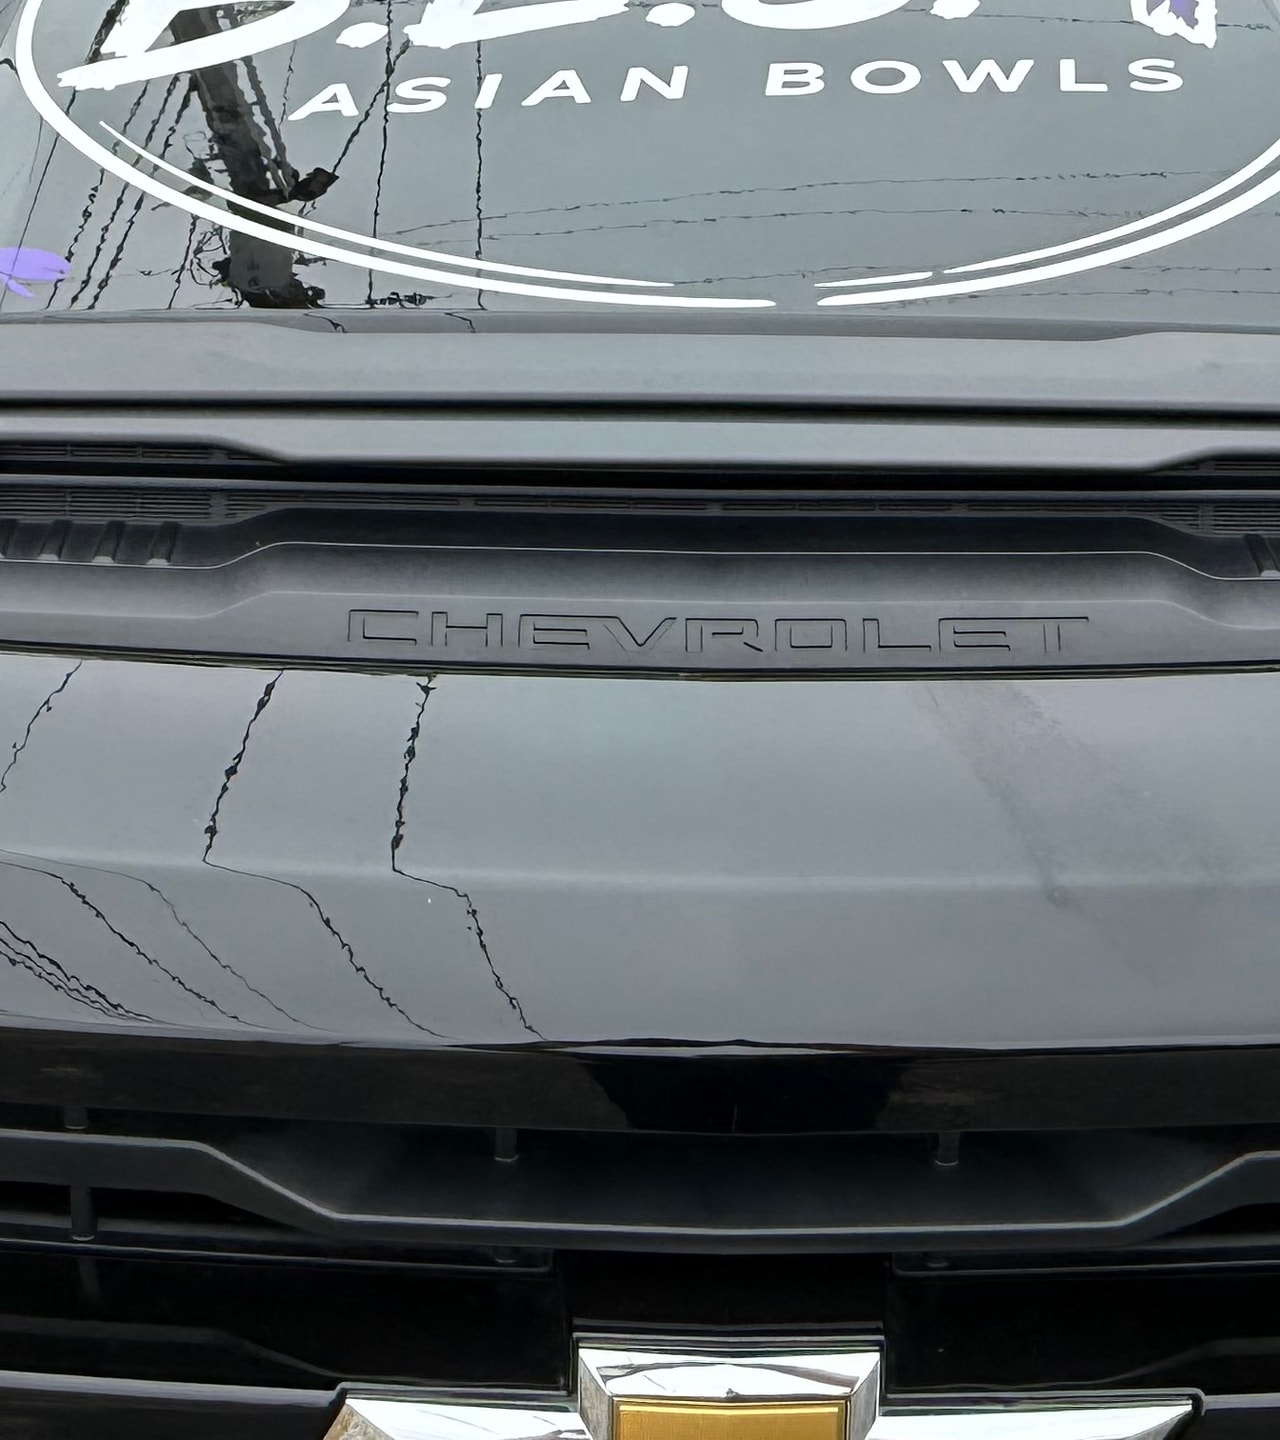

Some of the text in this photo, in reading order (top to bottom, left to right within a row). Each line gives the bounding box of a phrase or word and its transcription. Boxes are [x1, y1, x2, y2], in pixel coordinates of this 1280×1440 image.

[287, 57, 1184, 122] ASIAN BOWLS
[347, 608, 1090, 653] CHEVROLET
